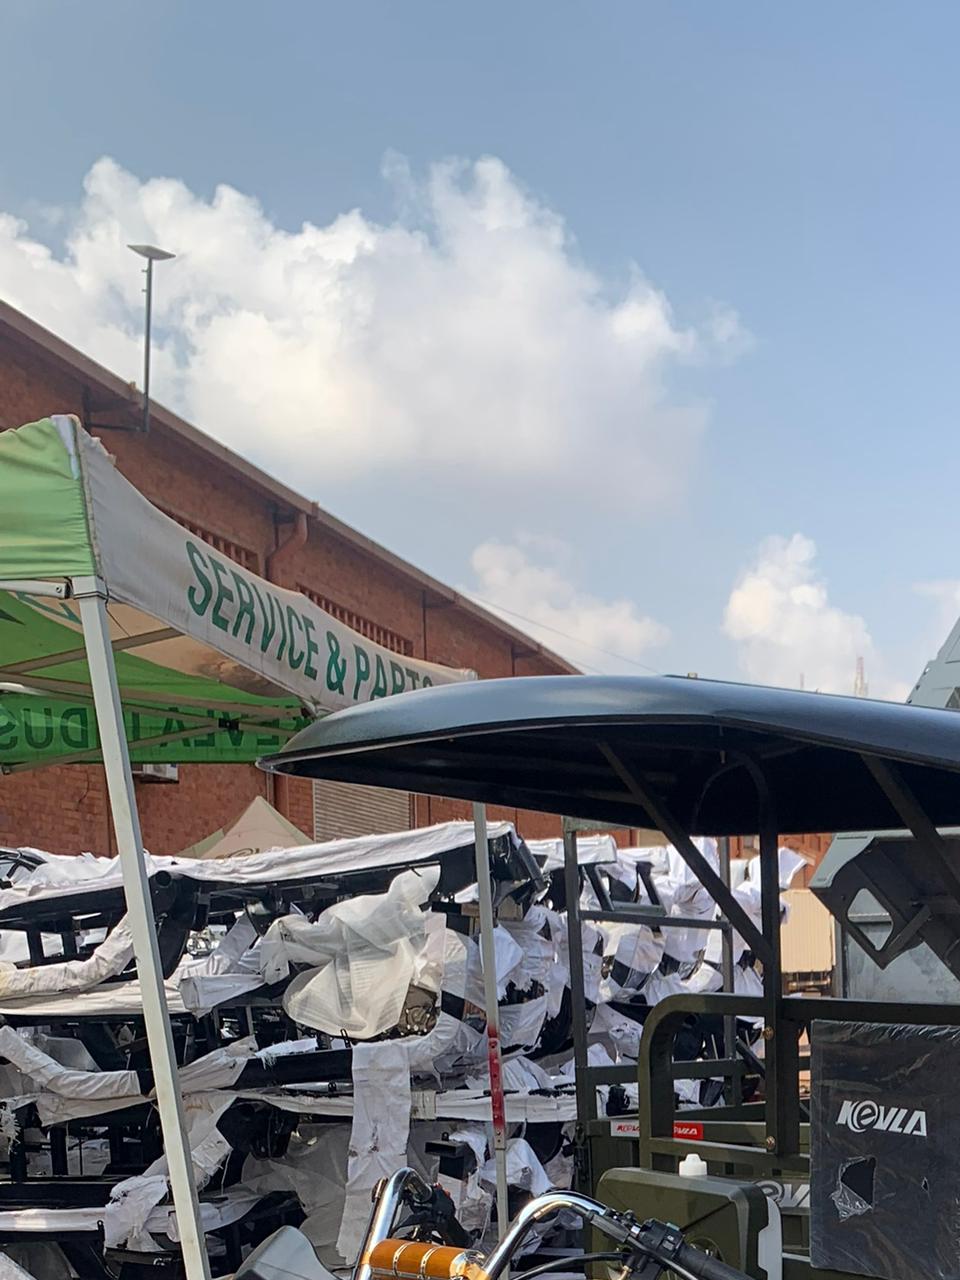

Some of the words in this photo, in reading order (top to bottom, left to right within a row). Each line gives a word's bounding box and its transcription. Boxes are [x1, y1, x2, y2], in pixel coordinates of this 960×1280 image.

[186, 541, 318, 680] SERVICE
[326, 631, 347, 695] &
[352, 644, 433, 700] PART
